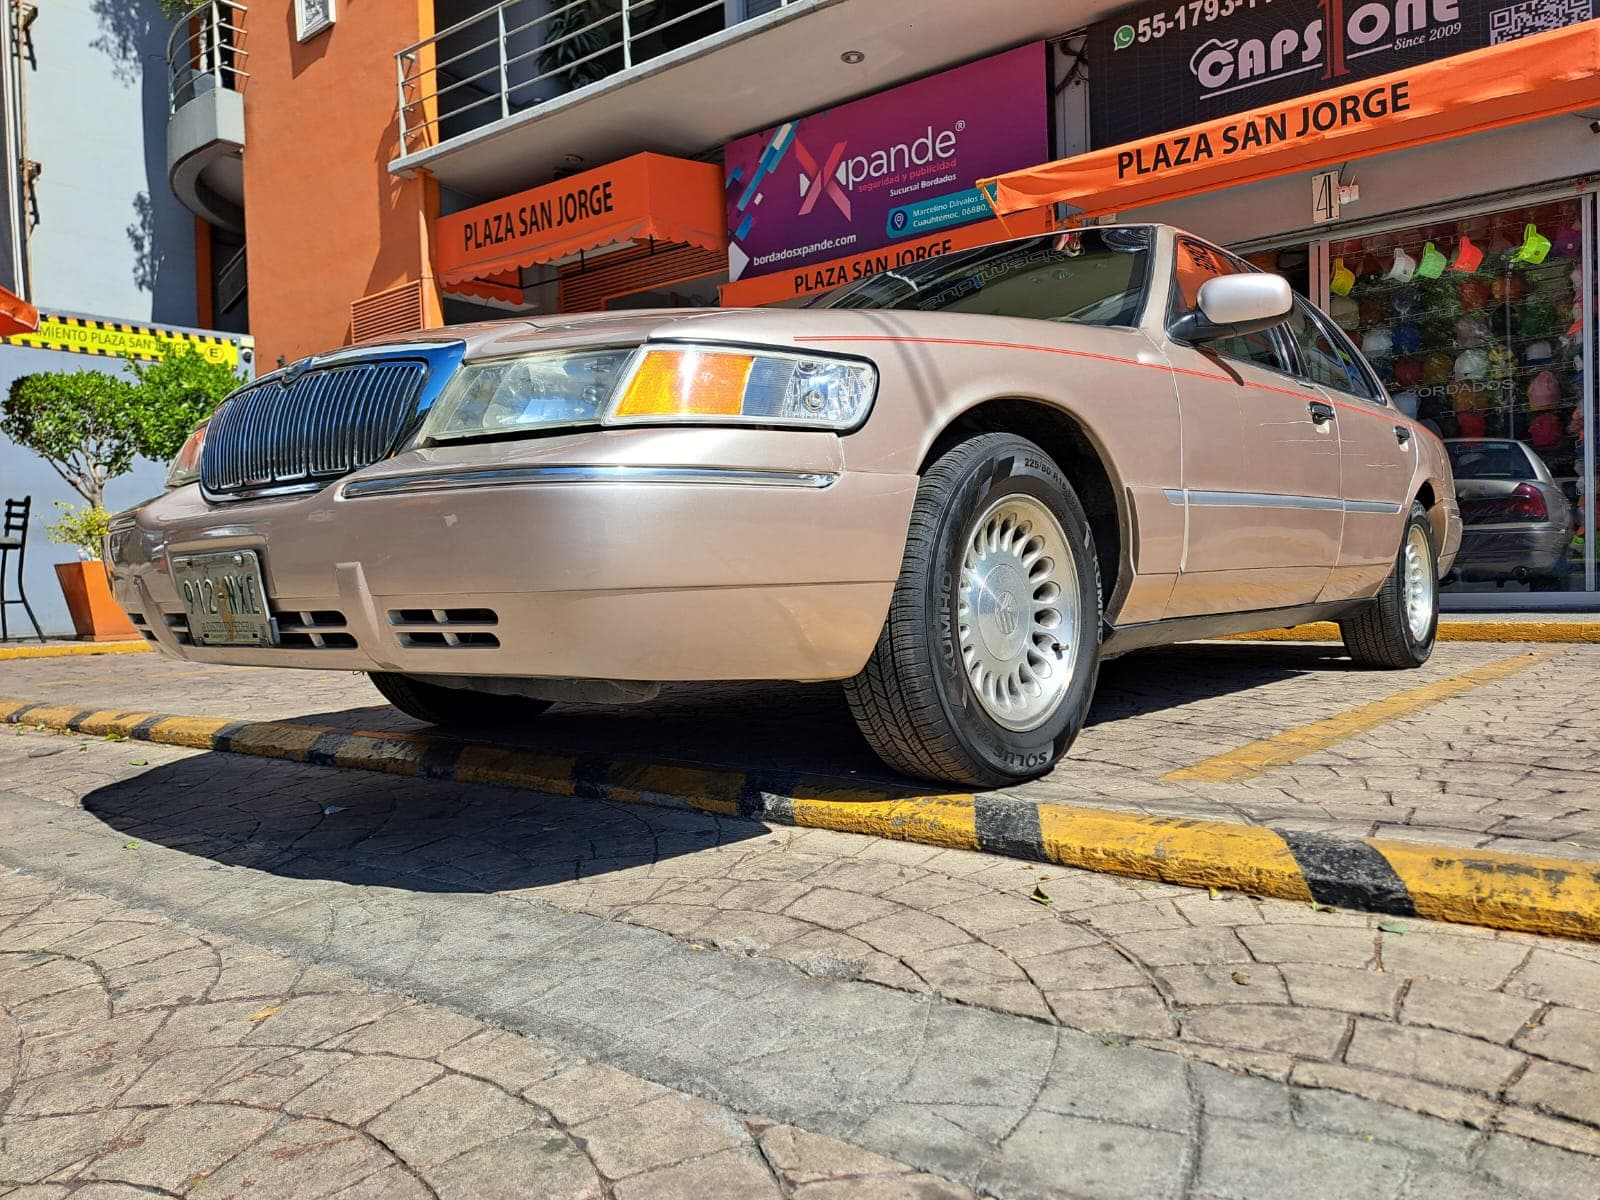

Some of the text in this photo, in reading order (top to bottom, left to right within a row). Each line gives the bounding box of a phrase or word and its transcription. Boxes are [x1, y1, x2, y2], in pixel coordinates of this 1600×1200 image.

[1394, 22, 1462, 51] Since 2009
[1118, 81, 1411, 179] PLAZA SAN JORGE
[857, 175, 900, 193] seguridad
[909, 158, 957, 180] publicidad
[889, 173, 957, 197] Sucursal Bordados
[912, 203, 948, 217] Marcelino
[1315, 173, 1334, 220] 4
[464, 181, 614, 251] PLAZA SAN JORGE
[753, 234, 857, 267] bordadosxpande.com
[794, 265, 849, 294] PLAZA
[852, 255, 889, 280] SAN
[37, 327, 88, 343] MIENTO
[90, 332, 125, 348] PLAZA
[128, 337, 152, 351] SAN
[209, 348, 218, 358] E
[1406, 379, 1513, 399] ORDADOS
[1093, 555, 1104, 646] KUMHO
[939, 571, 957, 680] KUMHO
